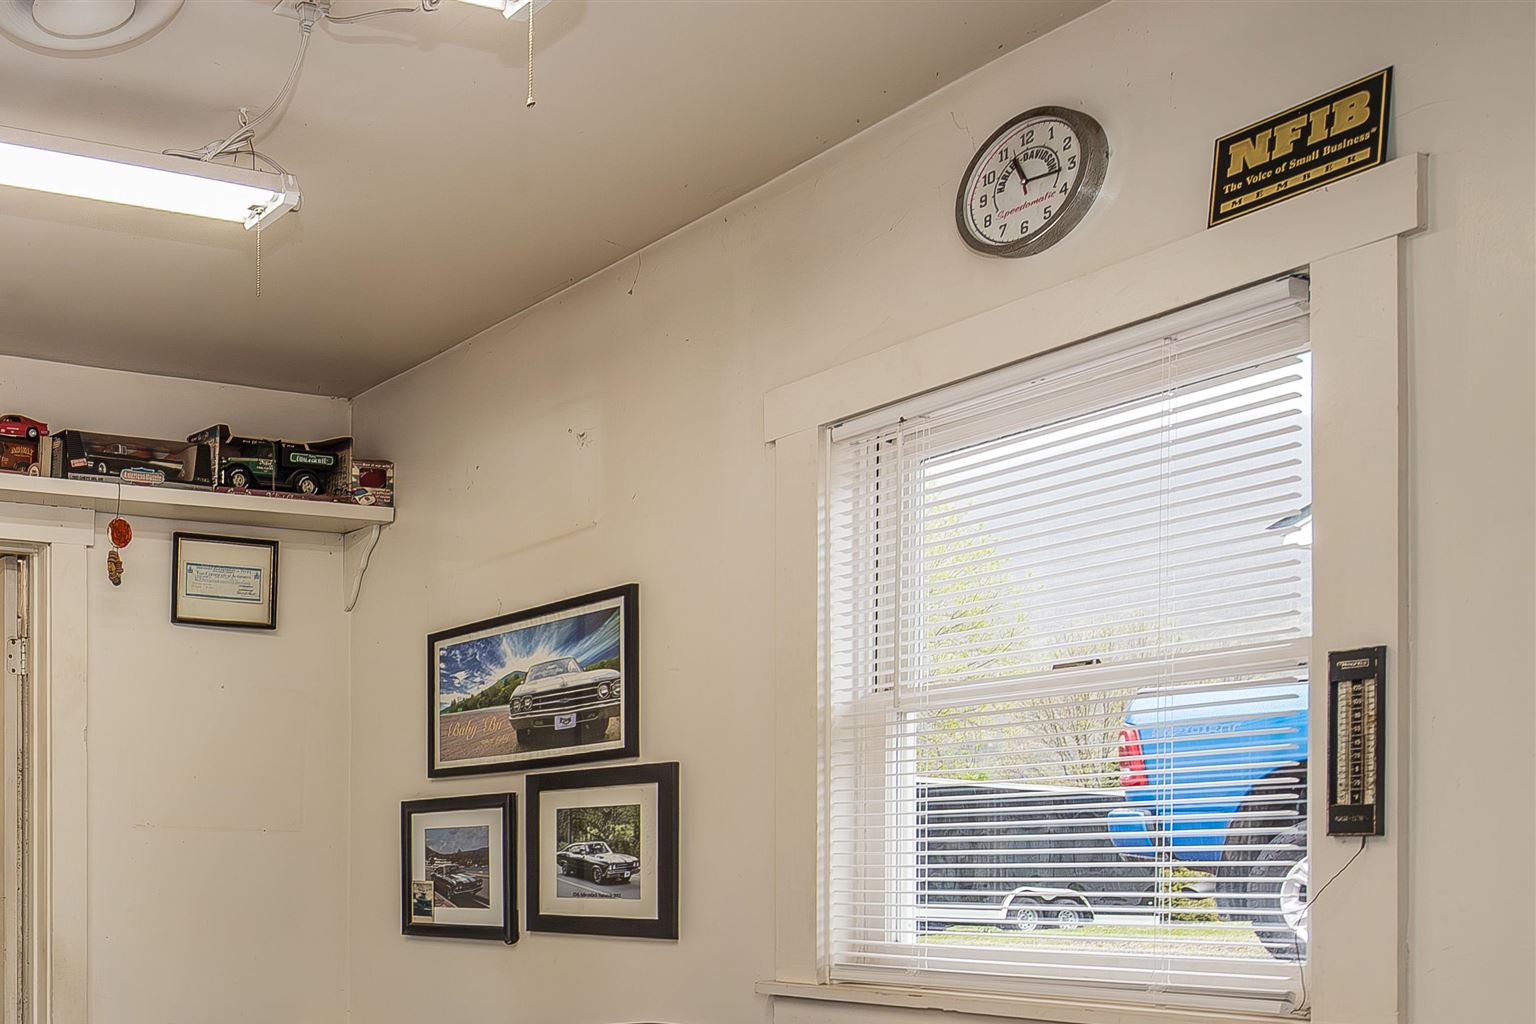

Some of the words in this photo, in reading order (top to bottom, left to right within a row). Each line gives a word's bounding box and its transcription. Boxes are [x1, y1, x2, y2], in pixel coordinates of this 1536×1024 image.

[1019, 130, 1034, 147] 12
[1048, 126, 1055, 141] 1
[1227, 90, 1371, 178] NFIB
[1063, 136, 1072, 152] 2
[998, 147, 1010, 163] 11
[1067, 155, 1077, 171] 3
[982, 171, 996, 187] 10
[1223, 182, 1243, 195] The
[1246, 168, 1273, 186] Voice
[1275, 164, 1286, 176] of
[1289, 150, 1320, 170] Small
[1059, 182, 1068, 196] 4
[979, 194, 988, 208] 9
[984, 215, 992, 228] 8
[1043, 206, 1052, 221] 5
[999, 224, 1007, 238] 7
[1020, 220, 1029, 234] 6
[448, 722, 478, 741] Baby
